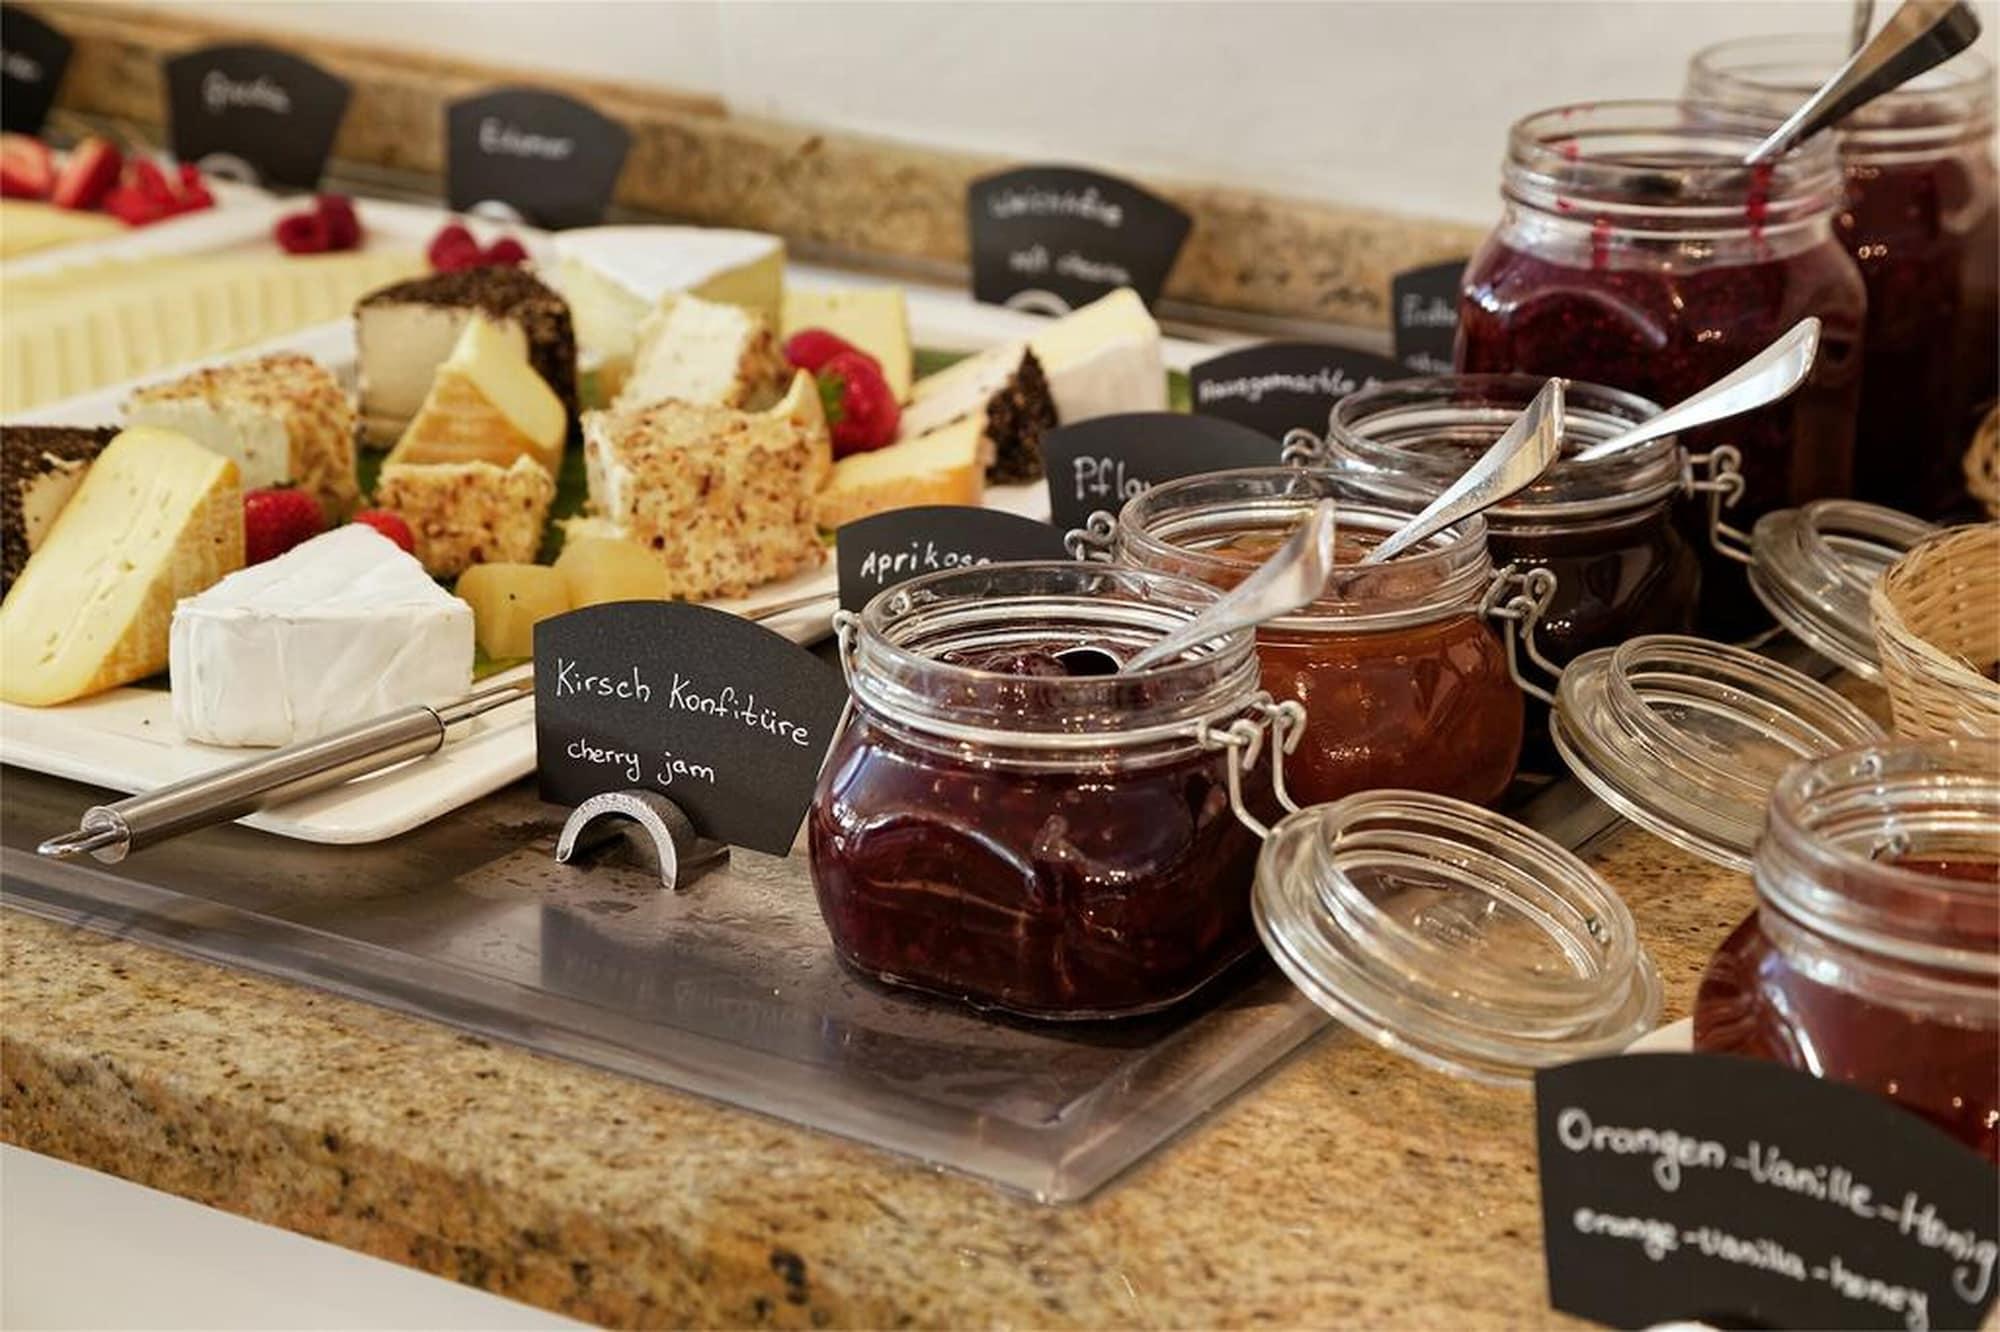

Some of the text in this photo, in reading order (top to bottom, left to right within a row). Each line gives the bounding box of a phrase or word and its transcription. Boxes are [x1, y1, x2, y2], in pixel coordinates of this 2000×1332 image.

[556, 657, 809, 746] Kirsch Konfitüre
[567, 738, 715, 785] cherry jam
